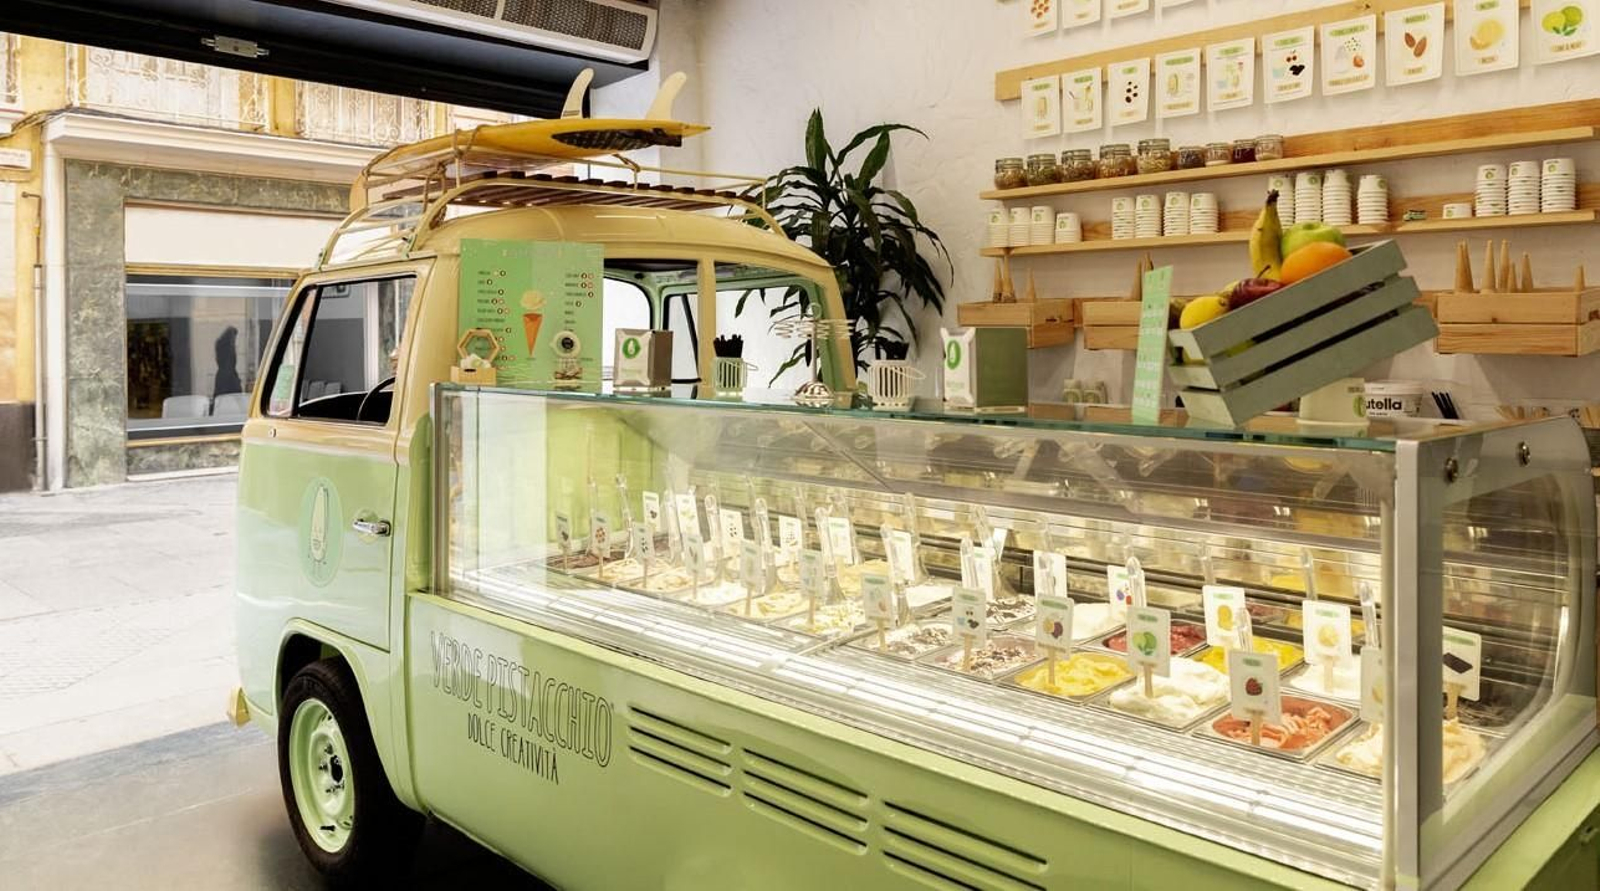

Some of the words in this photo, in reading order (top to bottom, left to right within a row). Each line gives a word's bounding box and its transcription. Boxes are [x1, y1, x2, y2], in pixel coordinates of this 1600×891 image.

[1365, 397, 1402, 411] utella
[430, 630, 483, 709] VERDE
[487, 653, 612, 768] PISTACCHIO
[467, 712, 496, 753] DOLCE
